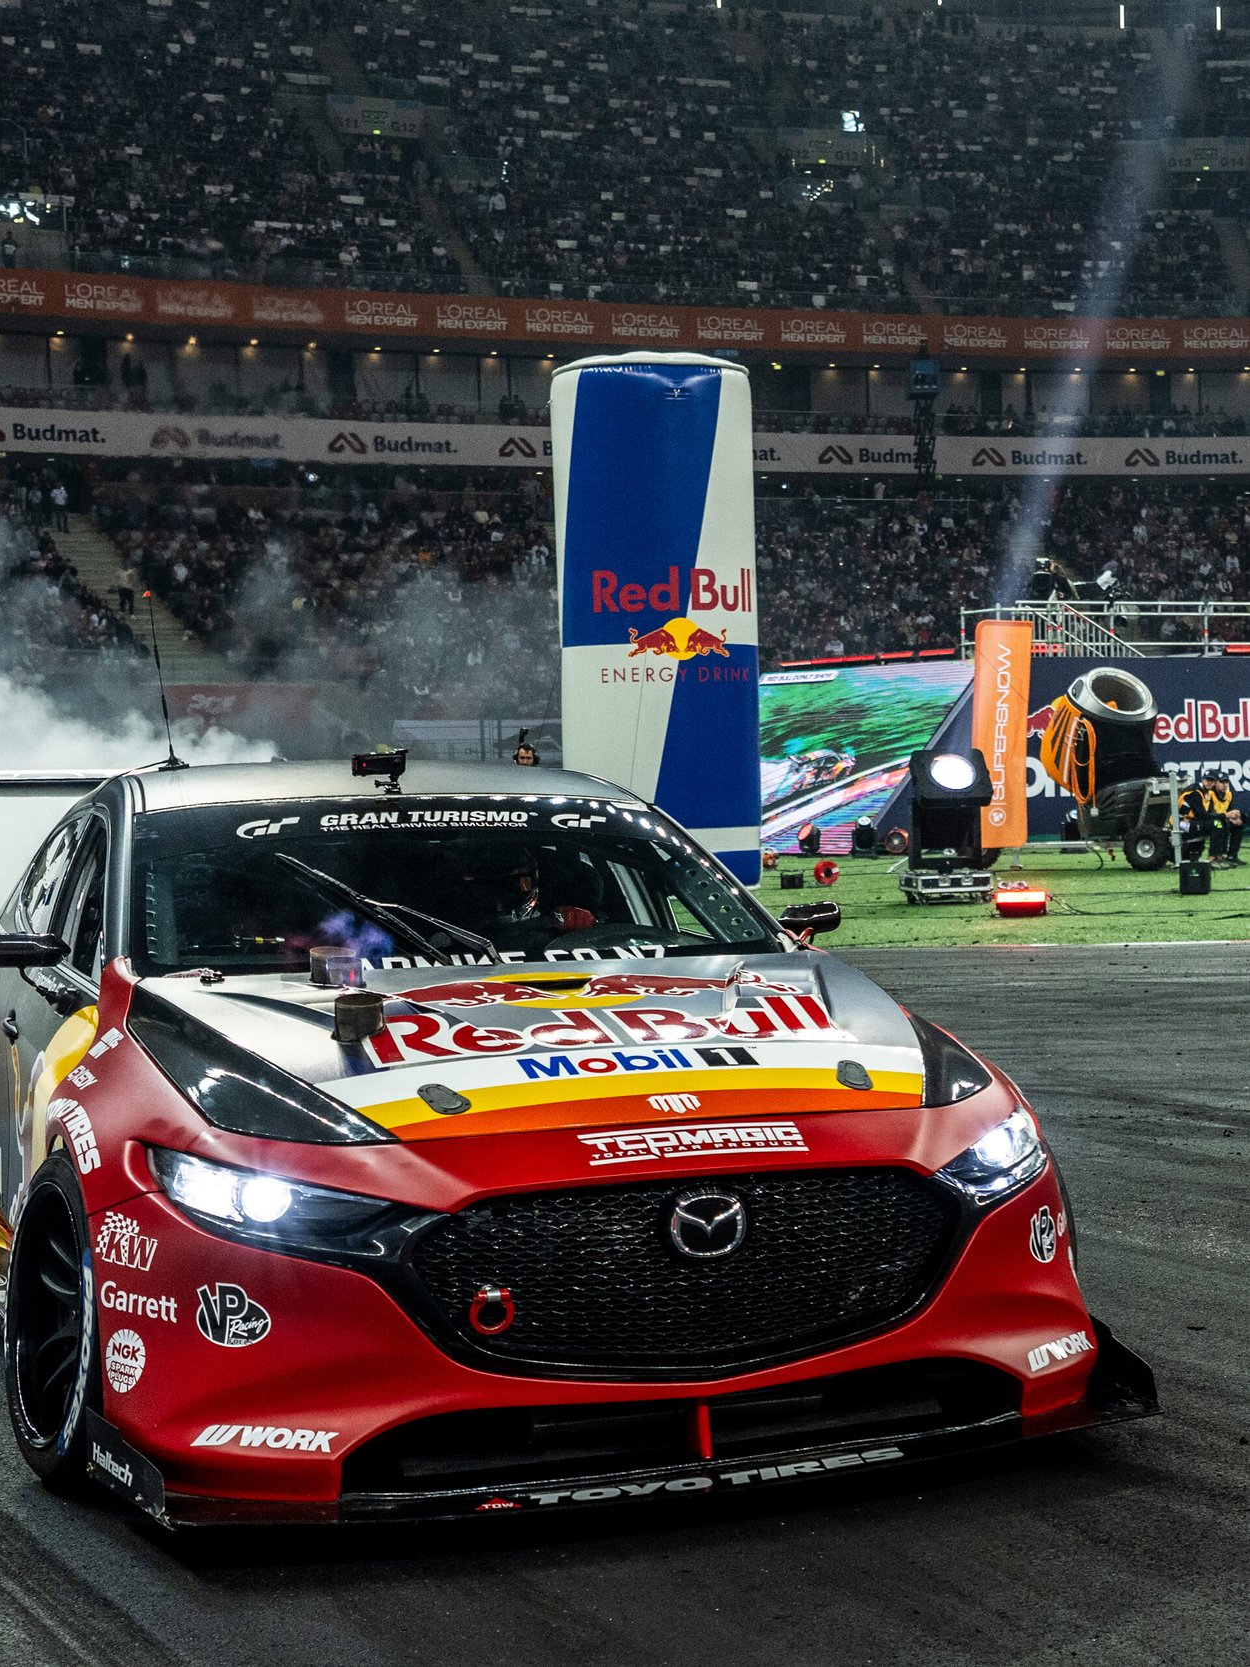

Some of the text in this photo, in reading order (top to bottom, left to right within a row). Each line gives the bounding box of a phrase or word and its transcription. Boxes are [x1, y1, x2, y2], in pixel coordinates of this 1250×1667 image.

[12, 424, 106, 444] Budmat.
[373, 436, 458, 457] Budmat.
[1012, 450, 1087, 466] Budmat.
[1166, 451, 1242, 466] Budmat.
[592, 565, 752, 613] Red Bull
[602, 667, 749, 684] ENERGY DRINK
[992, 643, 1013, 800] SUPERSNOW
[1153, 700, 1250, 742] ed Bul
[320, 810, 530, 827] GRAN TURISMO
[368, 994, 832, 1066] Red Bull
[517, 1047, 693, 1080] Mobil
[592, 1140, 806, 1160] TOTAL CAR PRODUCE
[101, 1228, 158, 1272] KW
[100, 1280, 178, 1324] Garrett
[196, 1282, 249, 1346] VP
[229, 1316, 270, 1338] Racing
[111, 1342, 139, 1362] NGK
[1050, 1330, 1095, 1361] WORK
[109, 1371, 135, 1386] PLUGS
[110, 1361, 136, 1376] SPARK
[238, 1424, 340, 1453] WORK
[92, 1441, 133, 1488] Haltech
[530, 1446, 905, 1507] TOYO TIRES
